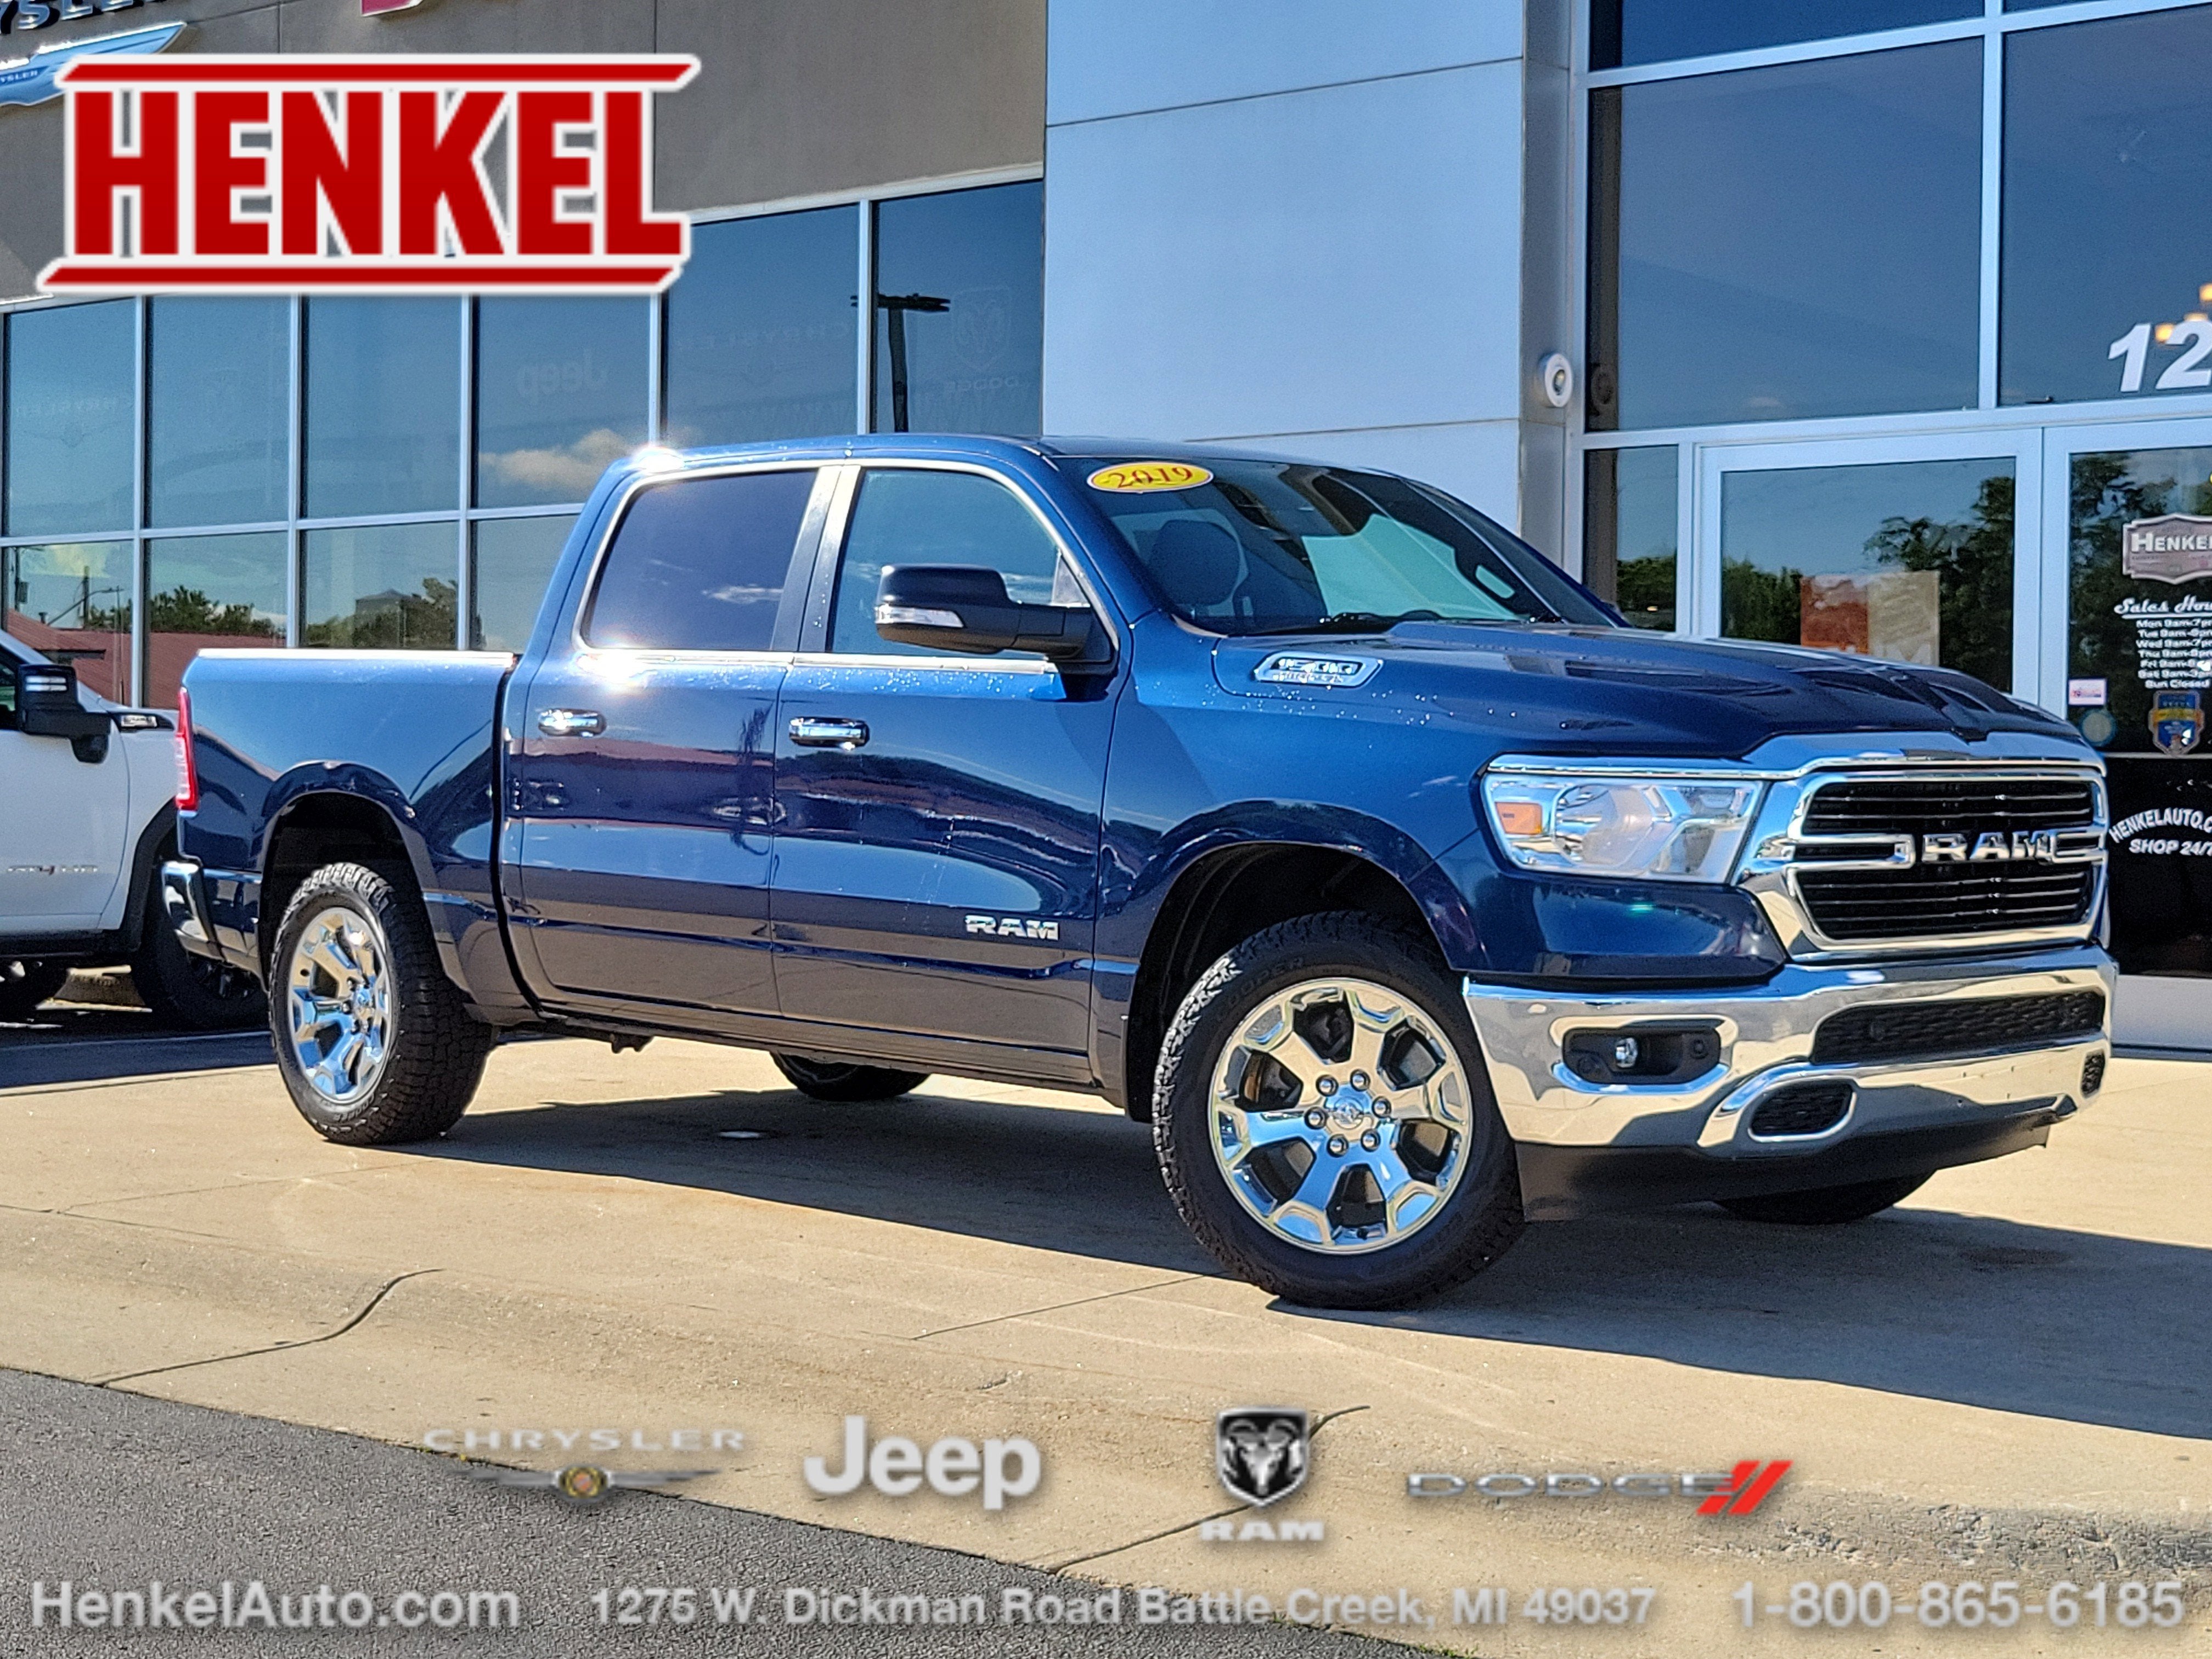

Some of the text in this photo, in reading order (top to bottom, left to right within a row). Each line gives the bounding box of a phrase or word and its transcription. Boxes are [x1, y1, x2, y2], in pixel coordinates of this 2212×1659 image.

[2108, 320, 2212, 393] 12
[1108, 467, 1193, 488] 2019
[2131, 532, 2212, 552] HENKE
[2114, 597, 2169, 614] Sales
[2145, 679, 2210, 689] Sun Closed
[1921, 830, 2053, 862] RAM
[2129, 838, 2180, 854] SHOP
[965, 915, 1059, 941] RAM
